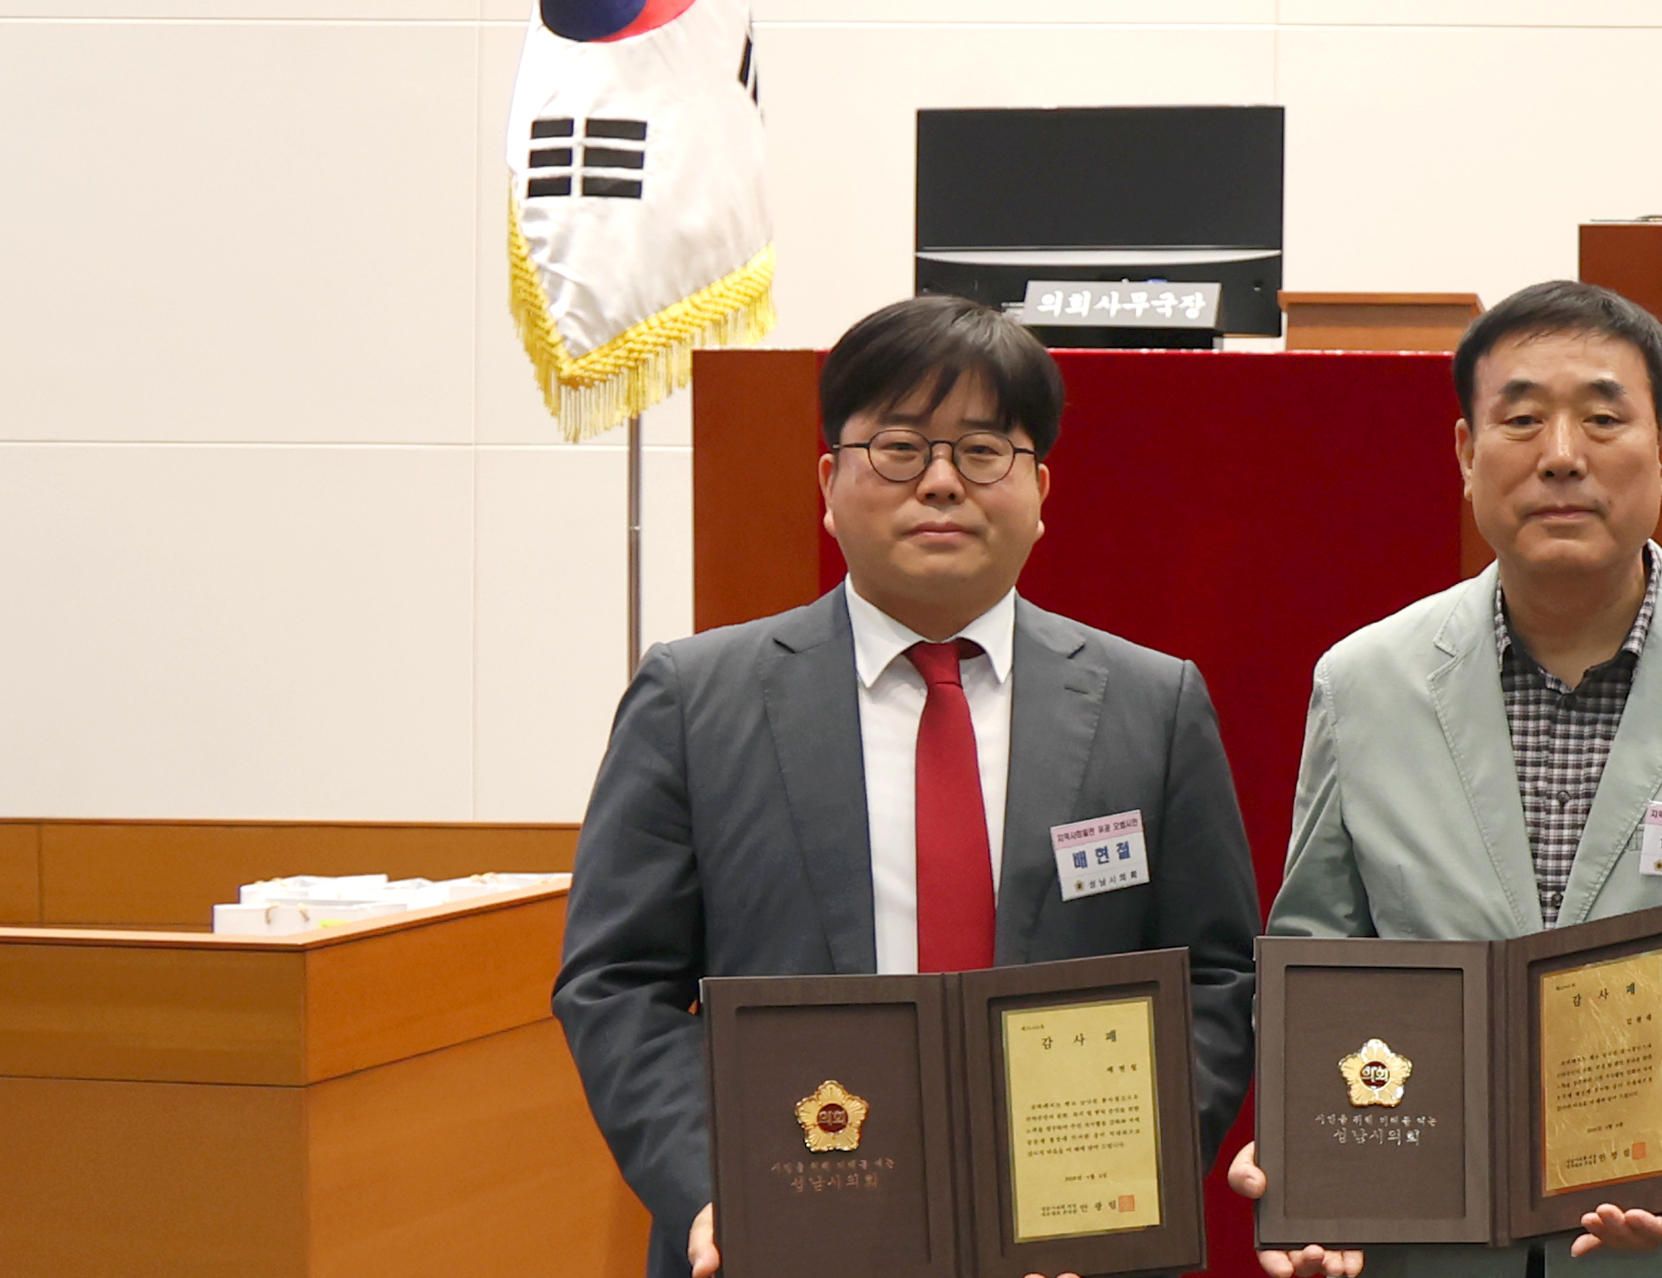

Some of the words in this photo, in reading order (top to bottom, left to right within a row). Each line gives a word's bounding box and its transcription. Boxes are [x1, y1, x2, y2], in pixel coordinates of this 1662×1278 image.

[1036, 290, 1208, 320] 의회사무국장
[1361, 1065, 1389, 1083] 의회
[818, 1110, 846, 1126] 의회
